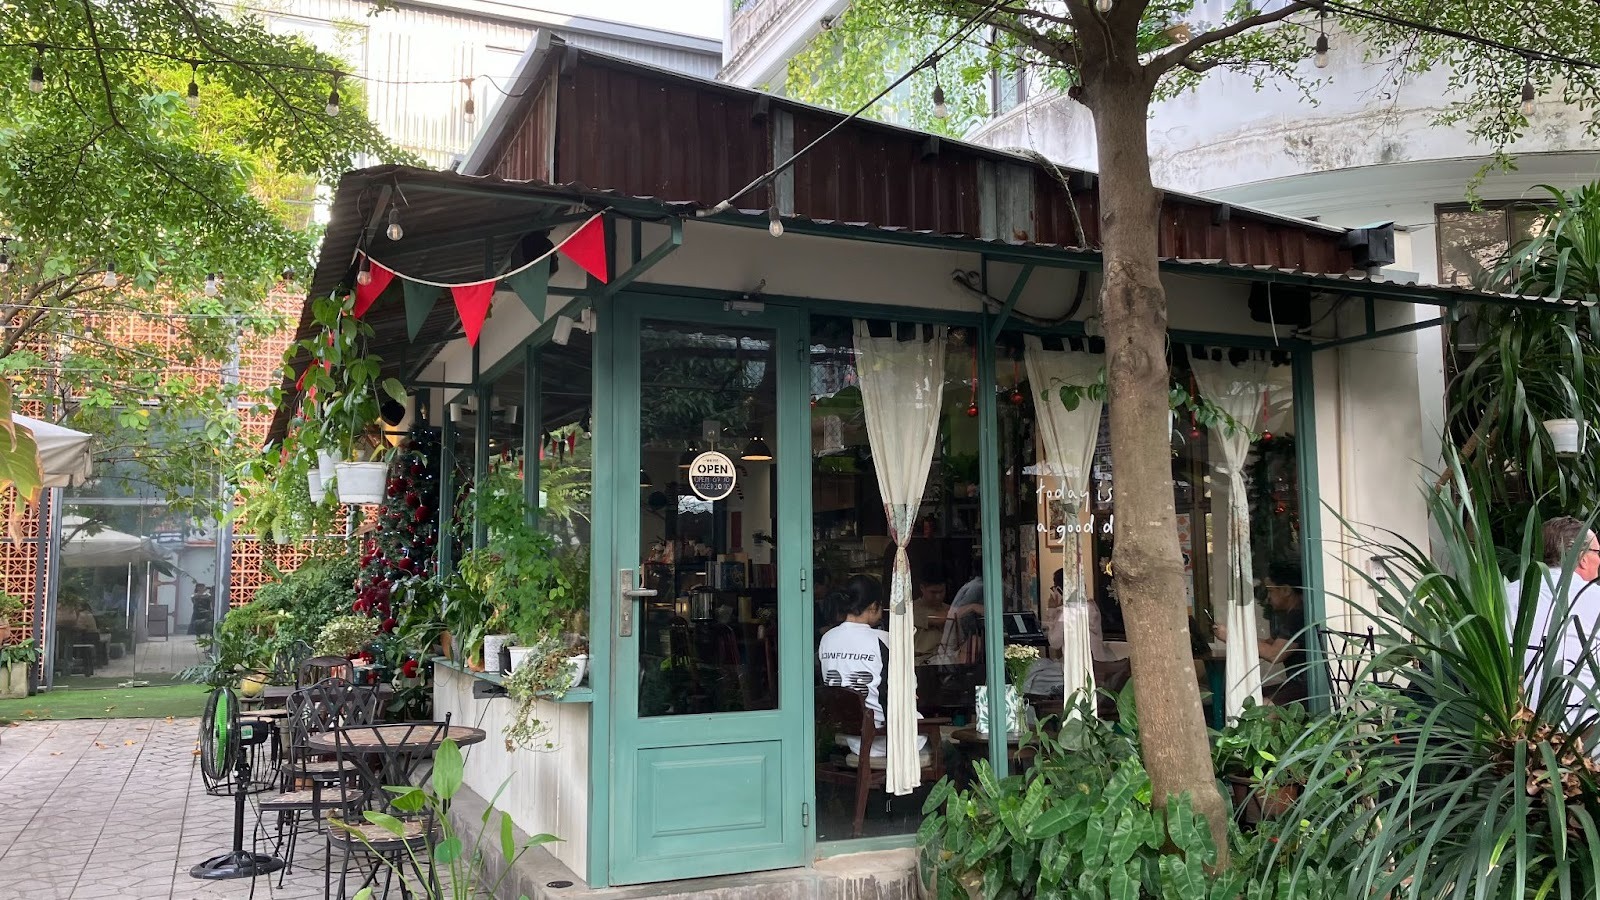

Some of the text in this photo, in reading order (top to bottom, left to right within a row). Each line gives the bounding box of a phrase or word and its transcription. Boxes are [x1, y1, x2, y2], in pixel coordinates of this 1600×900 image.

[697, 464, 728, 474] OPEN
[1036, 478, 1113, 512] today is
[1036, 523, 1048, 533] a
[1056, 514, 1095, 544] good
